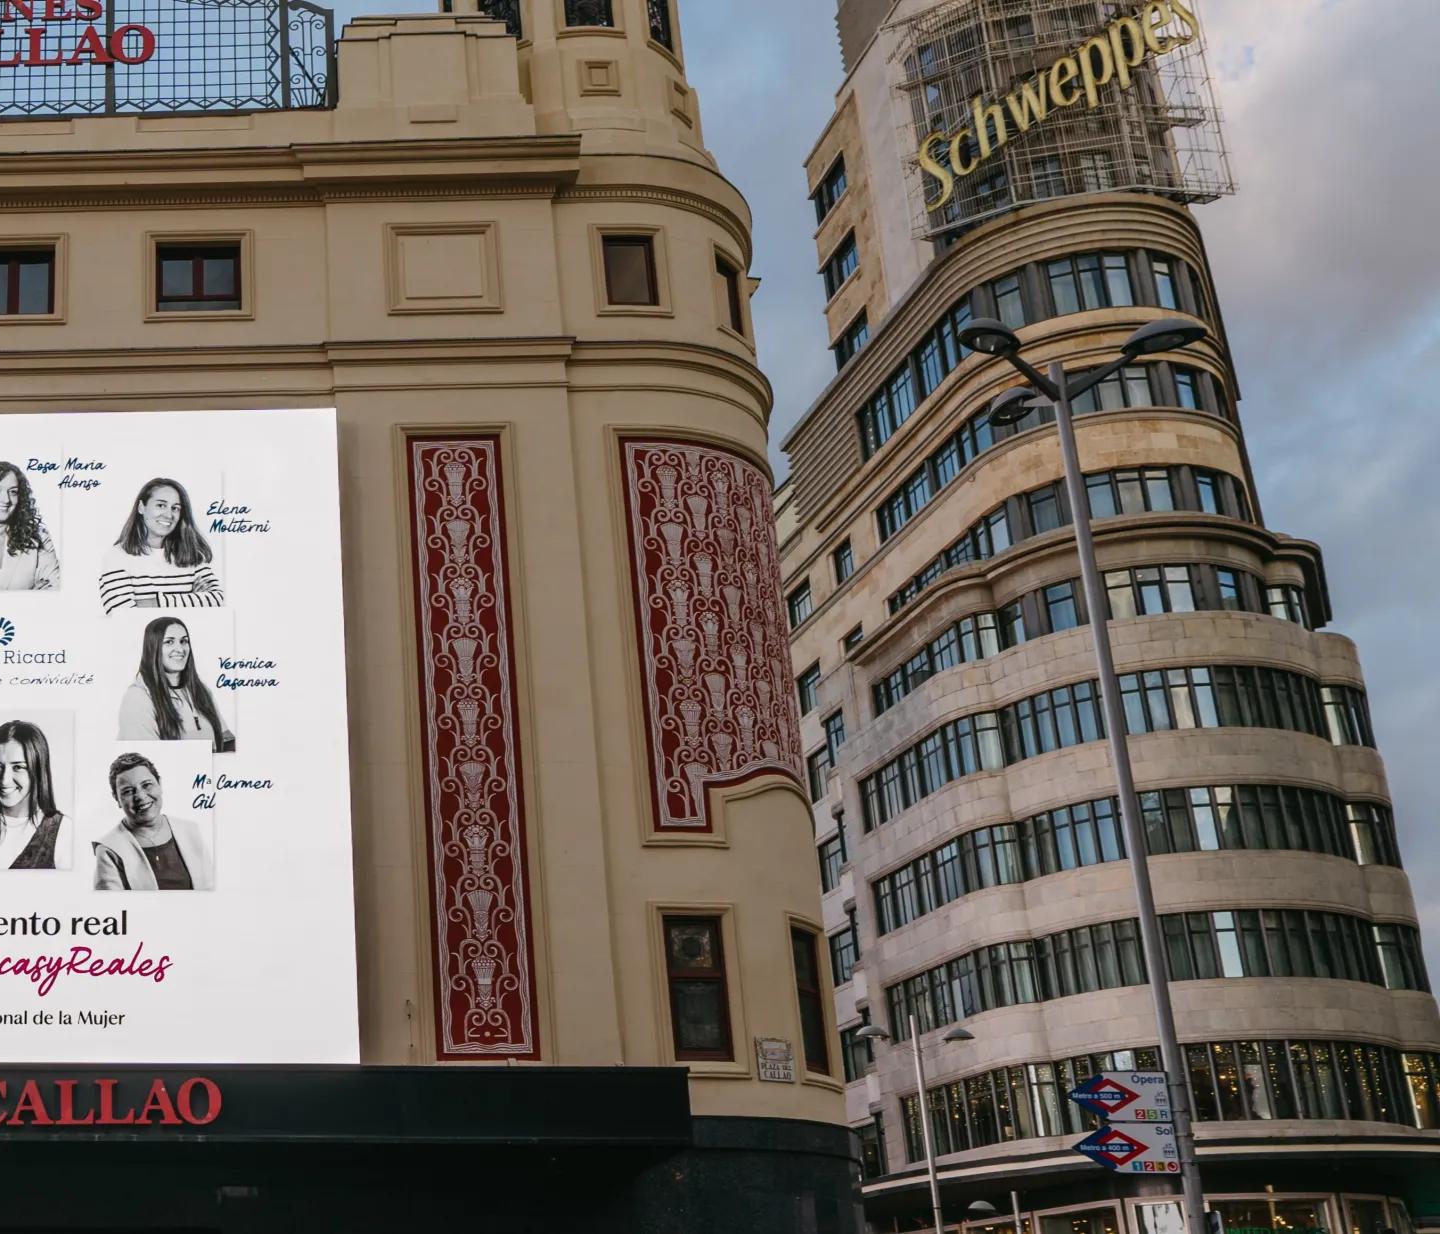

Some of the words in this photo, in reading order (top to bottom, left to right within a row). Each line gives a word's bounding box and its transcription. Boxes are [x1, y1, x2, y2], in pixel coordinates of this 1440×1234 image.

[918, 0, 1200, 213] Schweppes
[27, 459, 60, 474] Rosa
[58, 474, 101, 490] Alonso
[207, 500, 251, 515] Elena
[210, 518, 271, 533] Moliterni
[4, 650, 67, 664] Ricard
[10, 672, 94, 686] convivialité
[216, 674, 279, 690] Casanova
[217, 774, 273, 790] Carmen
[192, 792, 216, 810] Gil
[72, 910, 127, 936] real
[33, 1010, 53, 1025] de
[59, 1010, 73, 1025] la
[78, 1010, 126, 1029] Mujer
[764, 1070, 792, 1080] CALLAO
[1131, 1072, 1165, 1085] Ópera
[1155, 1126, 1174, 1136] Sol
